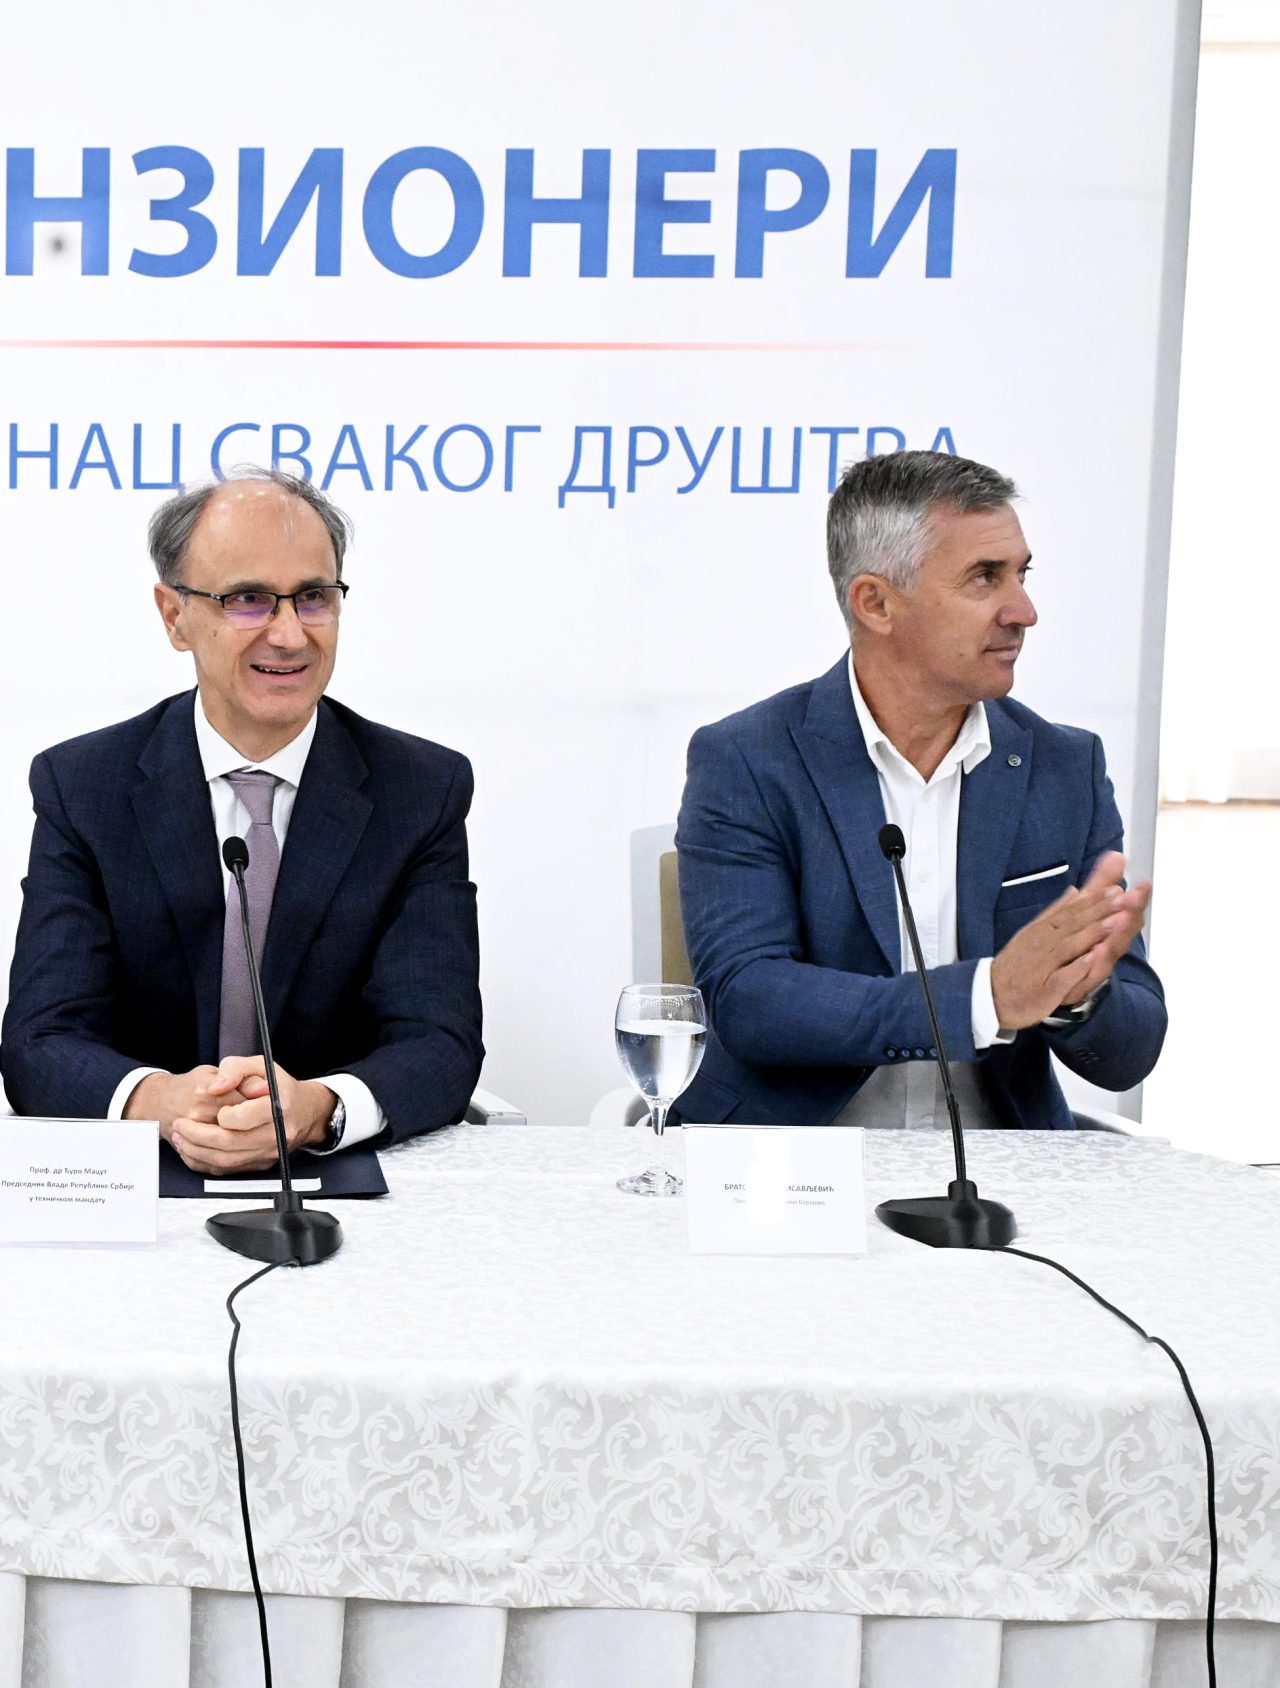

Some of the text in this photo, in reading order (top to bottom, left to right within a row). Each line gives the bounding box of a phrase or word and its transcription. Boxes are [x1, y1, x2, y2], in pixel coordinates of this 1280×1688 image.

[211, 423, 541, 492] СВАКОГ
[29, 1166, 52, 1175] Проф.
[1, 1180, 45, 1188] Председник
[70, 1181, 109, 1190] Републике
[110, 1182, 135, 1191] Србије
